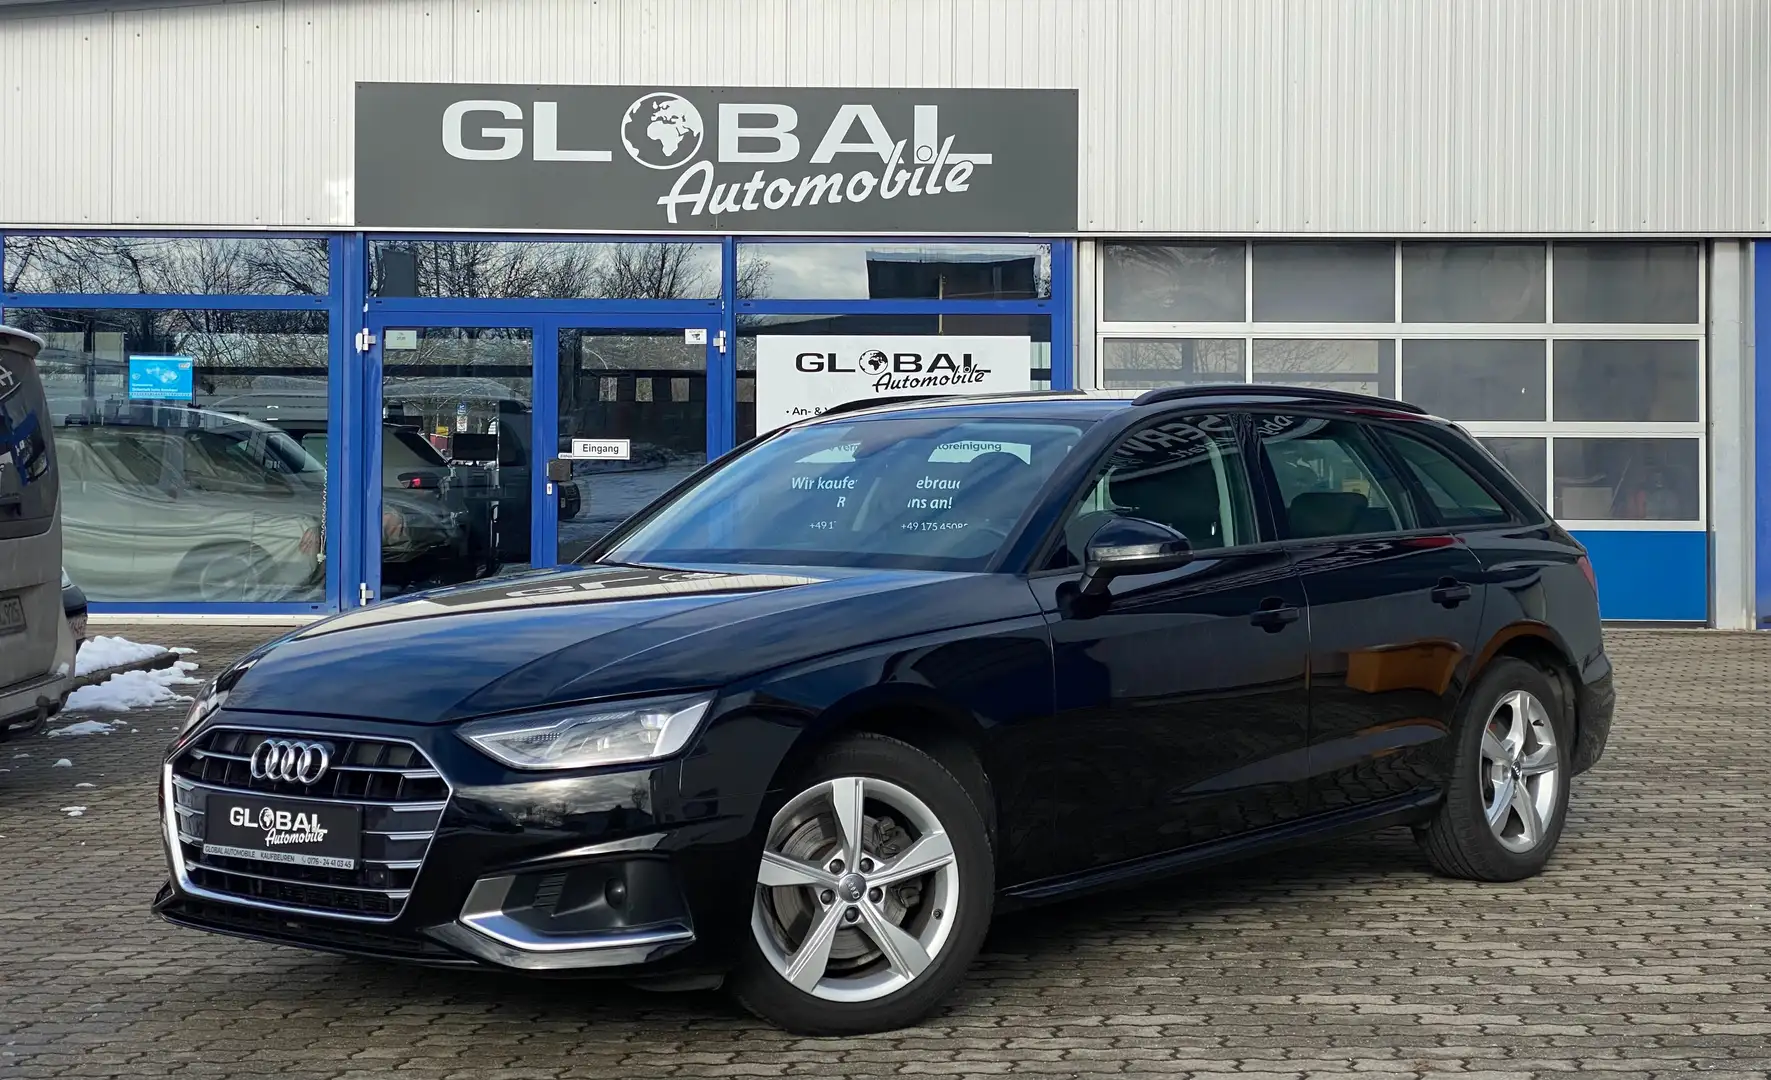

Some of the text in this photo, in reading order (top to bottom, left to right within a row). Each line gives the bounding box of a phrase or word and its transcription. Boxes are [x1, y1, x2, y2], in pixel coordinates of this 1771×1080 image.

[442, 92, 992, 168] GLOBAL
[656, 132, 975, 224] Automobile
[795, 349, 992, 376] GLOBAL
[871, 363, 985, 393] Automobile
[791, 406, 812, 416] An-
[582, 443, 619, 454] Eingang
[791, 476, 815, 490] Wir
[817, 475, 858, 490] kaufe
[929, 496, 953, 509] an!
[809, 520, 827, 530] +49
[900, 522, 919, 531] +49
[921, 522, 938, 531] 175
[229, 806, 328, 834] GLOBAL
[264, 824, 324, 847] Automobile
[204, 846, 224, 855] GLOBAL
[224, 848, 256, 858] AUTOMOBILE
[260, 851, 295, 862] KAUFBEUREN
